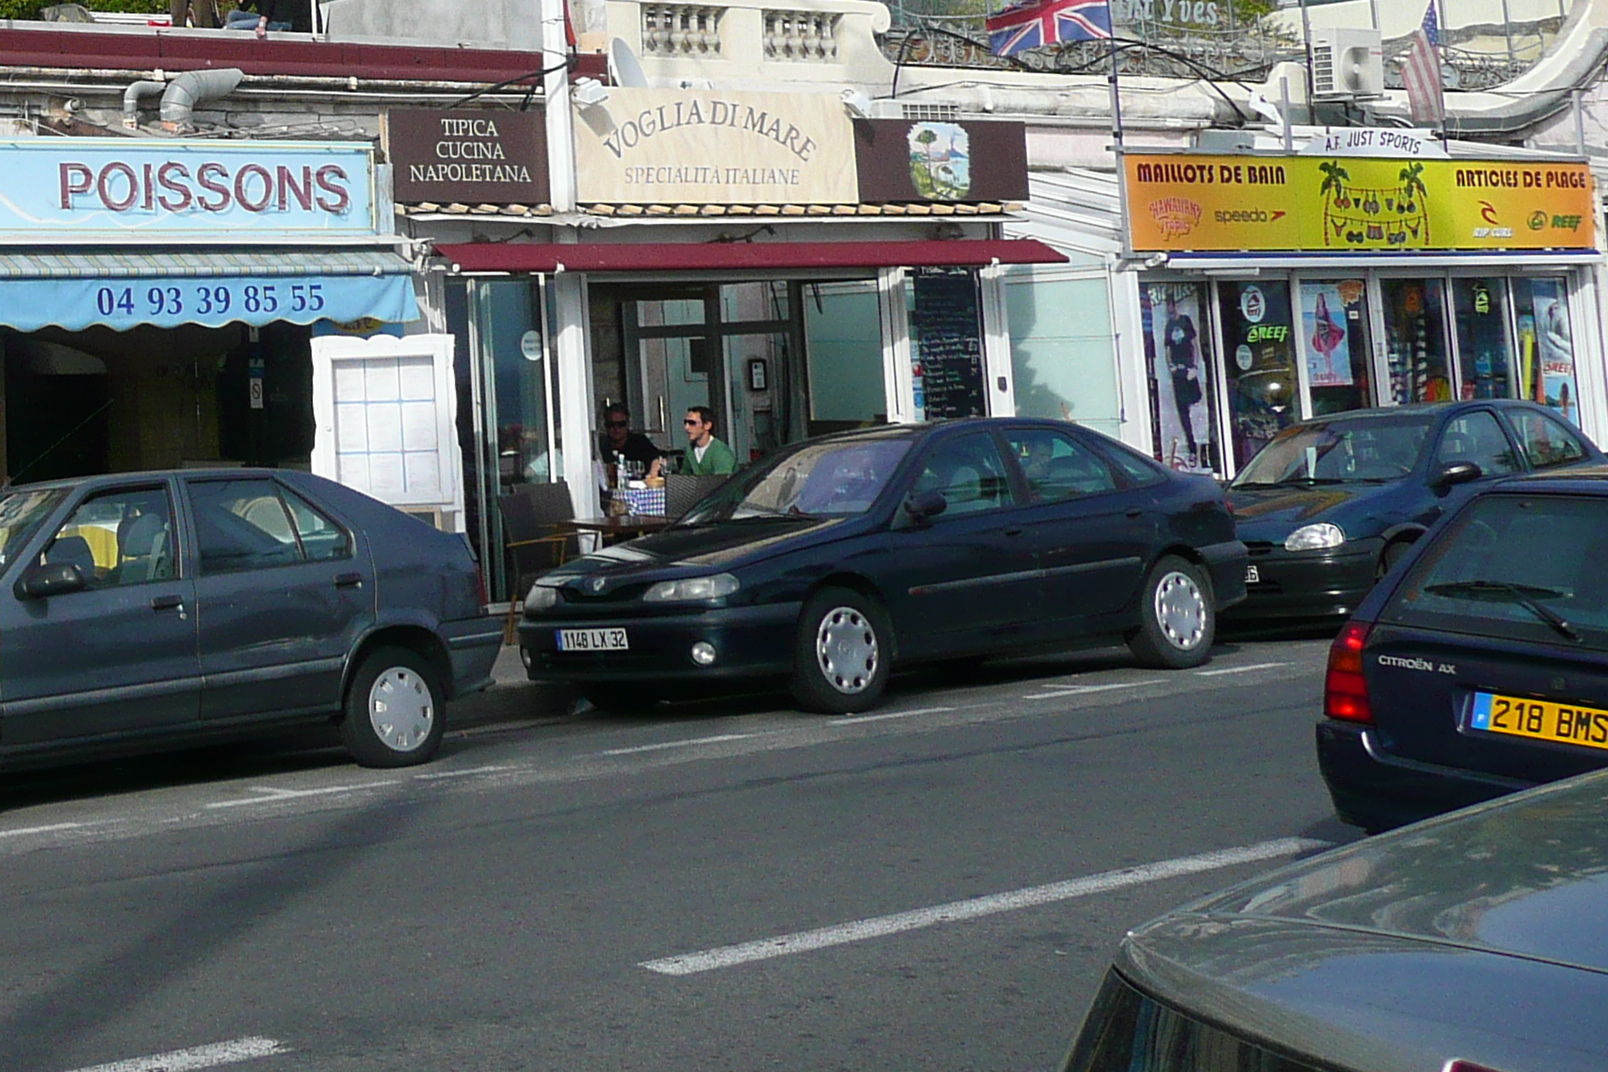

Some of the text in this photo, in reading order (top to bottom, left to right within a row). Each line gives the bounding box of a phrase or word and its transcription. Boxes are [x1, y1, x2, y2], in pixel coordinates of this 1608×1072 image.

[441, 118, 500, 137] TIPICA
[603, 99, 817, 162] VOGLIA DI MARE
[436, 141, 506, 160] CUCINA
[1347, 130, 1374, 148] JUST
[1379, 131, 1422, 155] SPORTS
[409, 164, 533, 183] NAPOLETANA
[724, 167, 800, 186] ITALIANE
[1136, 163, 1286, 185] MAILLOTS DE BAIN
[1455, 168, 1587, 189] ARTICLES DE PLAGE
[59, 161, 352, 214] POISSONS
[1215, 207, 1268, 224] speedo
[1551, 214, 1583, 232] REEF
[97, 287, 135, 316] 04
[147, 286, 183, 316] 93
[196, 286, 231, 315] 39
[243, 285, 278, 313] 85
[291, 284, 325, 312] 55
[564, 630, 626, 649] 1148 LX 32
[1377, 653, 1457, 676] CITROËN AX
[1493, 699, 1608, 744] 218 BMS
